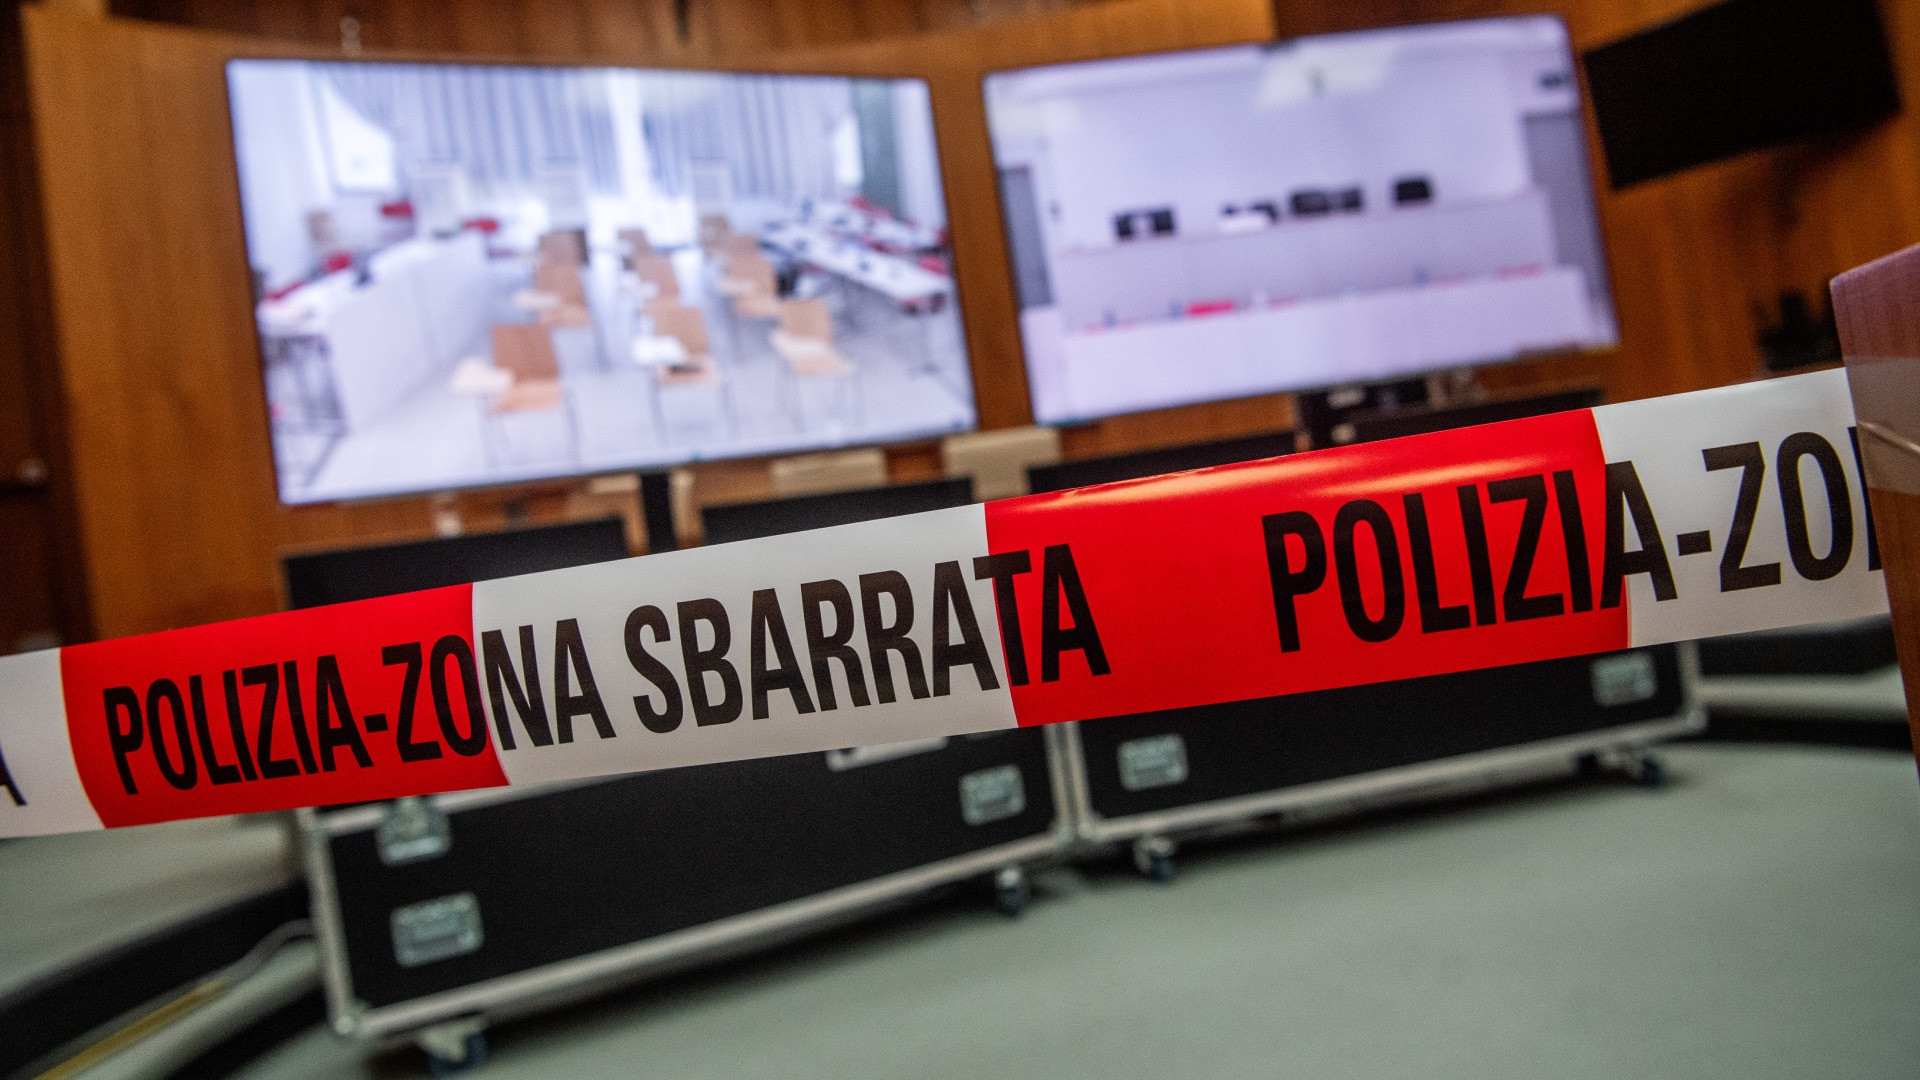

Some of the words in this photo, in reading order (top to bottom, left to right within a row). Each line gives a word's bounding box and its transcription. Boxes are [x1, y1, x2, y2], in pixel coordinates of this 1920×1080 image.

[1261, 426, 1884, 653] POLIZIA-ZO
[103, 617, 615, 795] POLIZIA-ZONA
[623, 543, 1111, 734] SBARRATA
